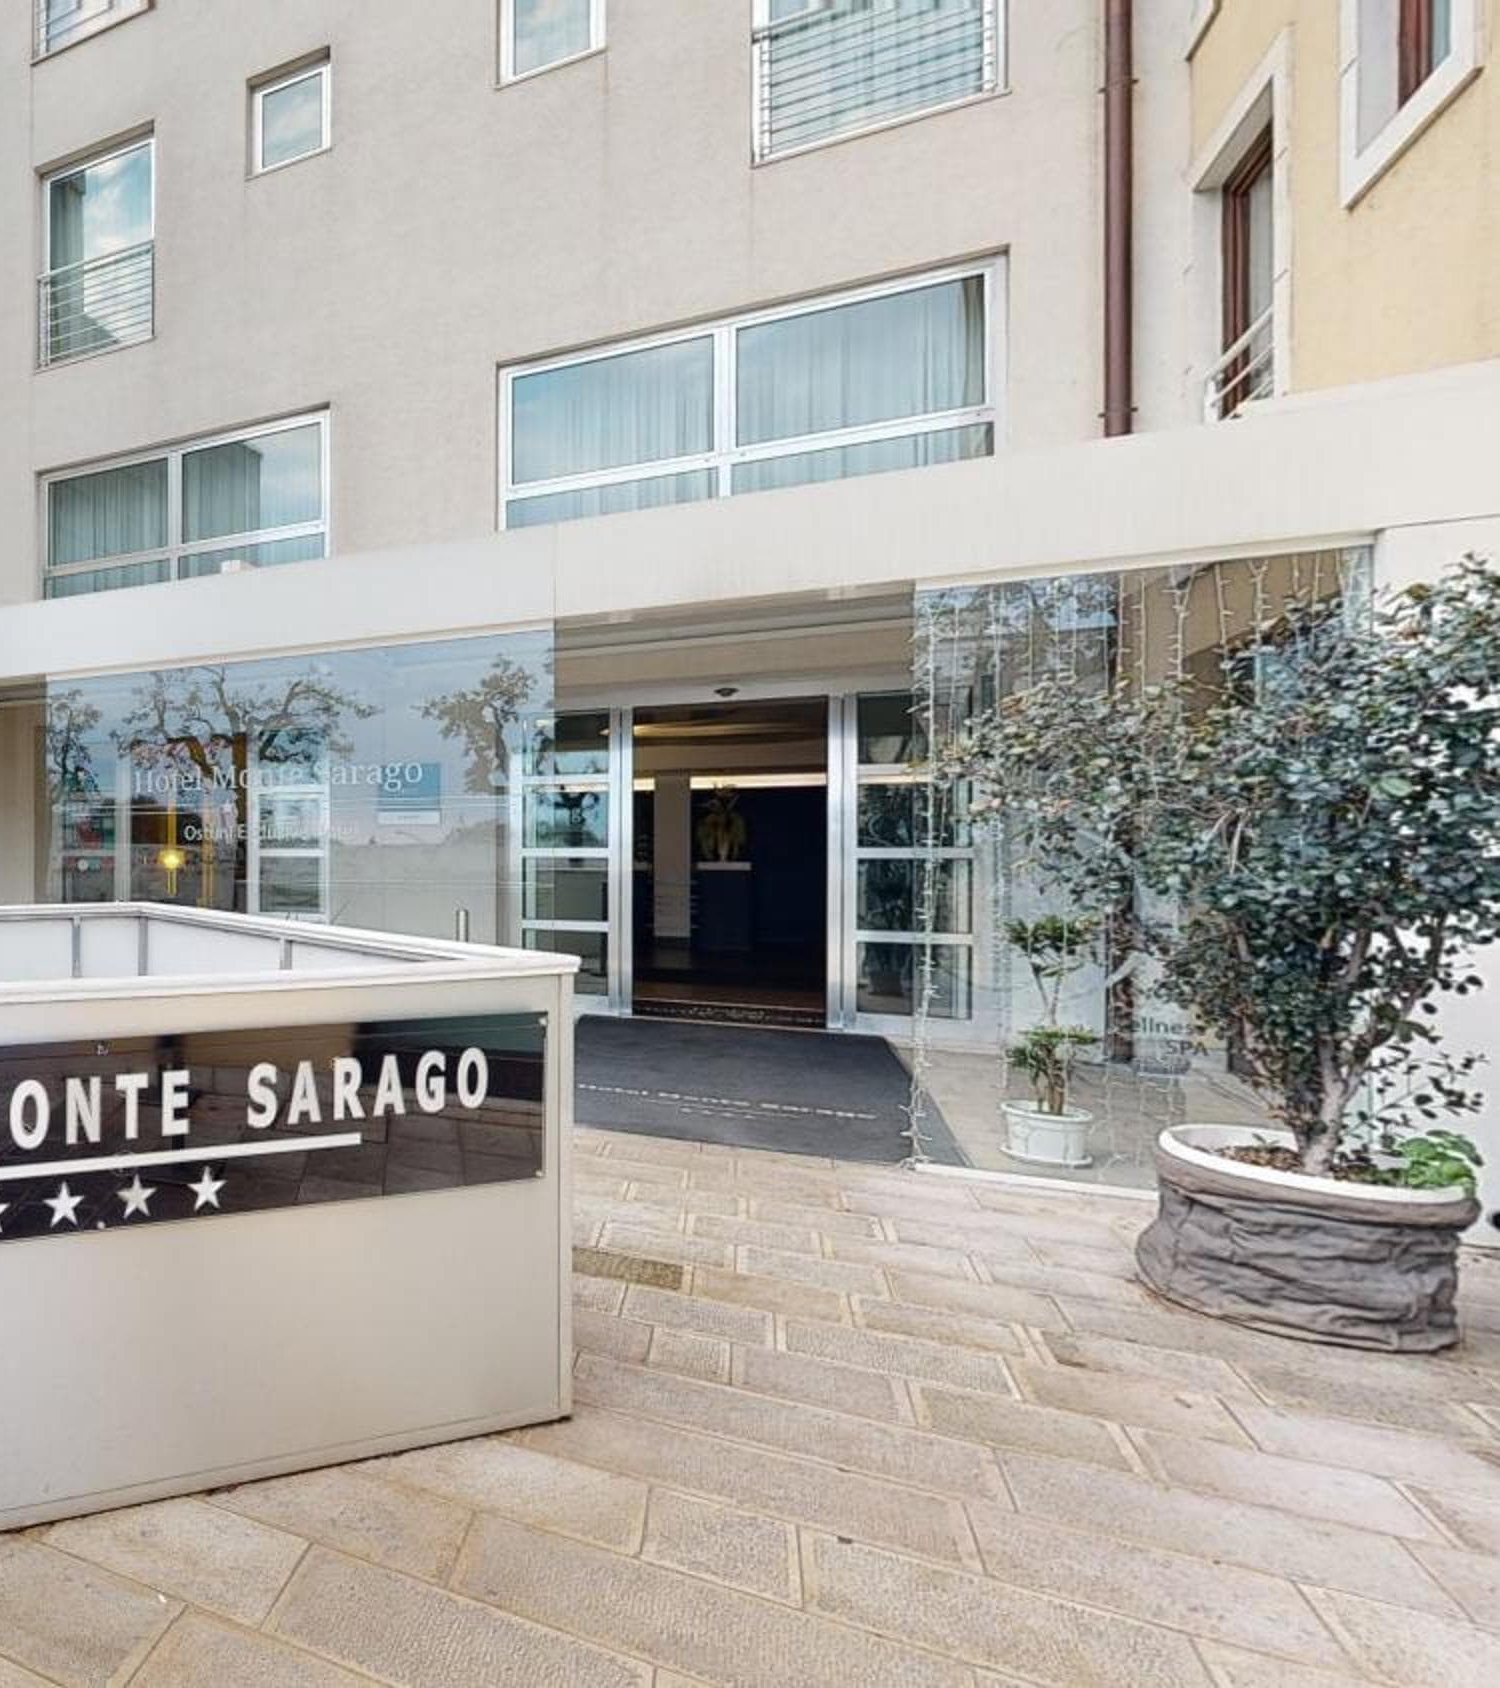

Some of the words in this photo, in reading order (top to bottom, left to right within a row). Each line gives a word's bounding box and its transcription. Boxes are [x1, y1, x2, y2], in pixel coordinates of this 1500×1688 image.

[134, 764, 203, 794] Hotel
[211, 764, 306, 791] Monte
[313, 760, 424, 792] Sarago
[245, 1047, 489, 1129] SARAGO
